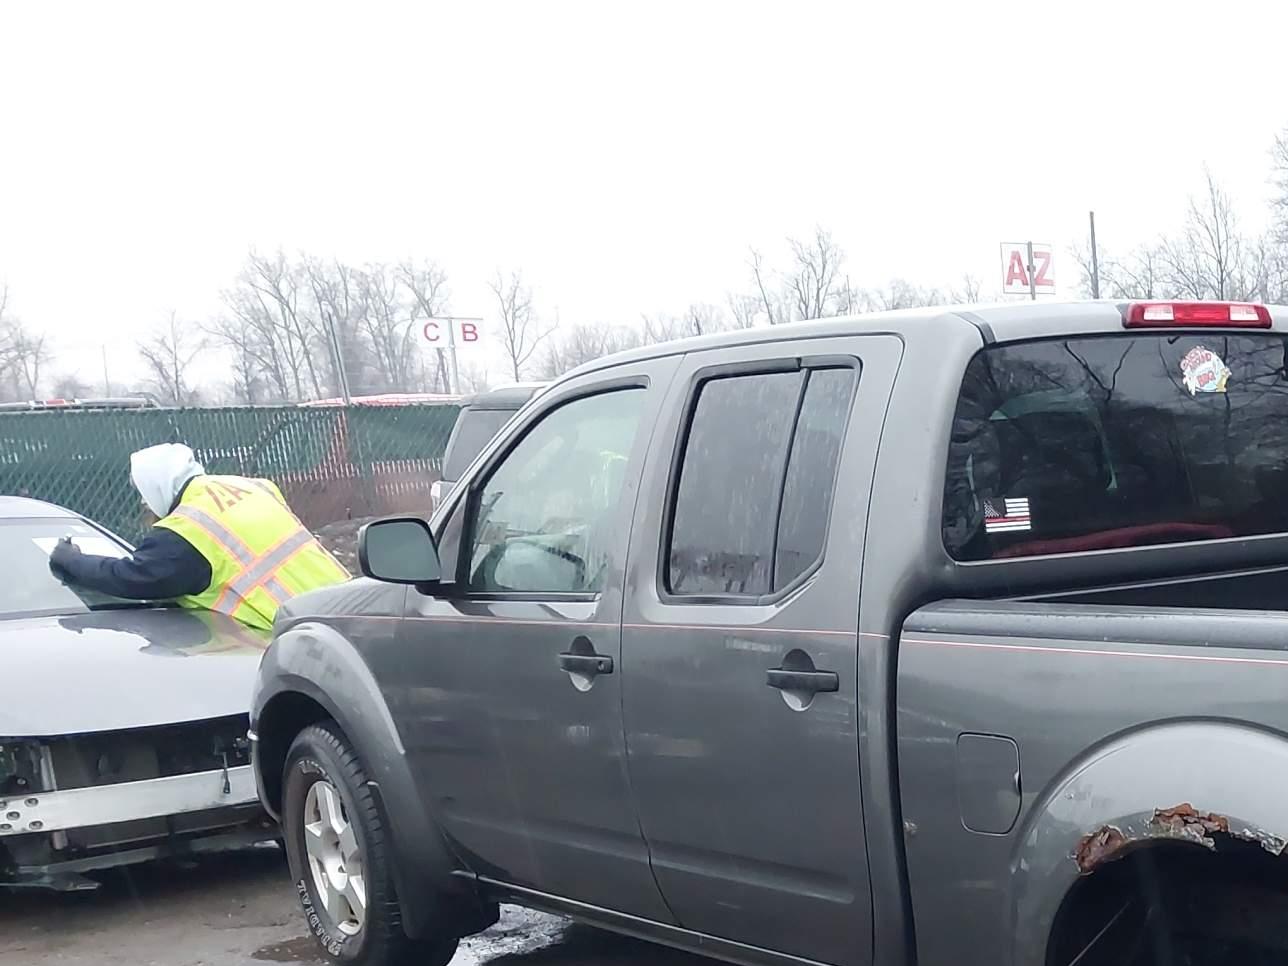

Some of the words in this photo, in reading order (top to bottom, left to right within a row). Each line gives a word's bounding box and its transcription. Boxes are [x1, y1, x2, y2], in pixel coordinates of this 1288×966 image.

[1005, 250, 1054, 286] AZ
[423, 322, 440, 342] C
[461, 322, 479, 342] B
